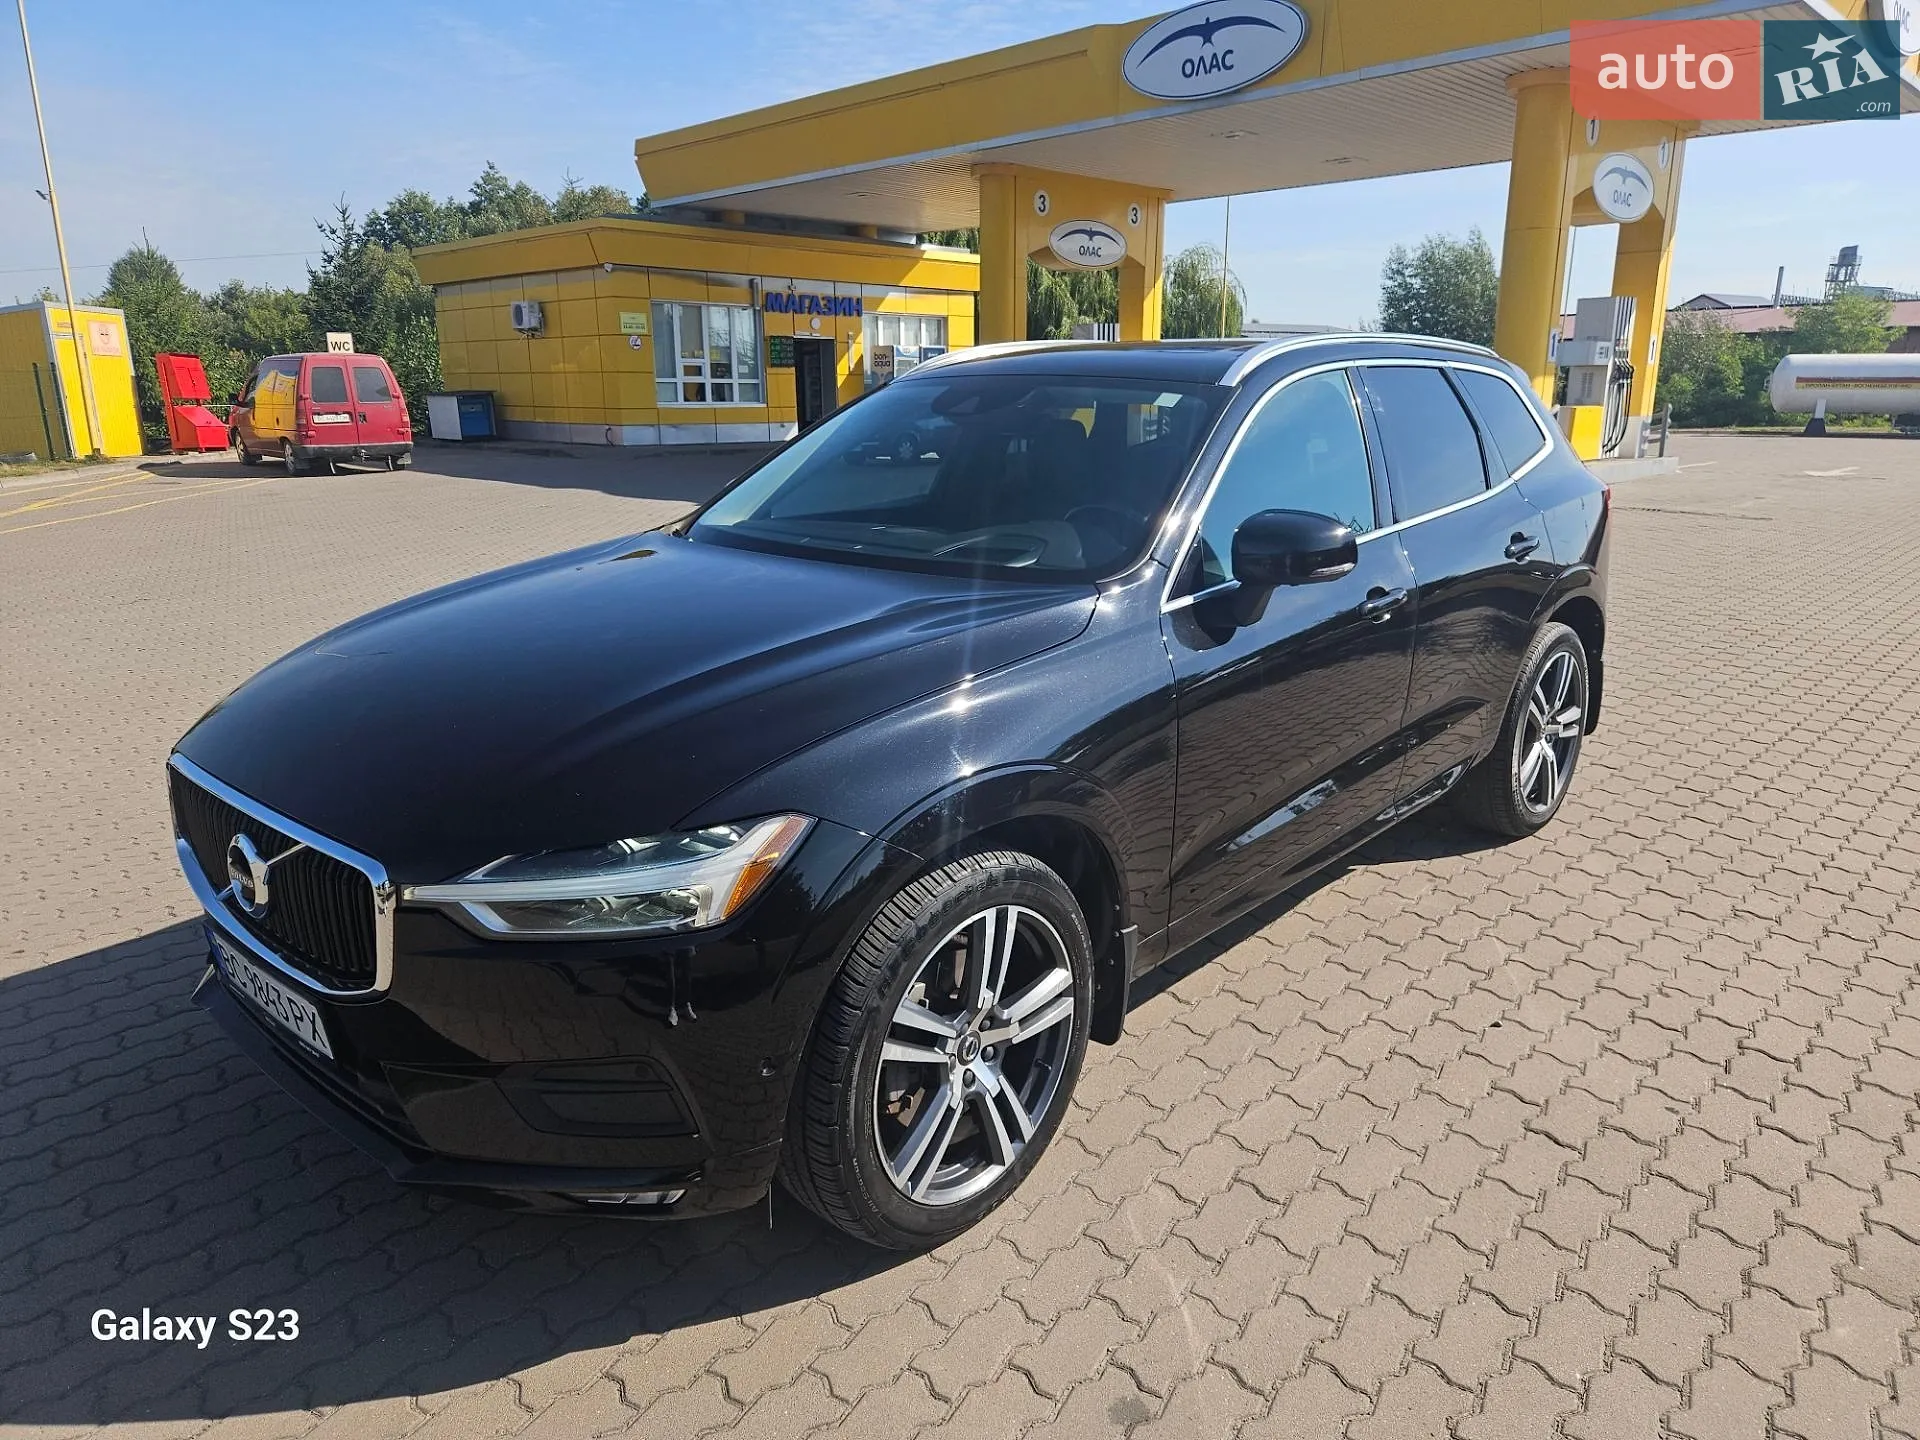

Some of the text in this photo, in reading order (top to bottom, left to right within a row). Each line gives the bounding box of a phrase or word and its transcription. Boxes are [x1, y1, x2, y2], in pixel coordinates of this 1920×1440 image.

[1181, 49, 1235, 78] ОЛАС
[1038, 194, 1047, 213] 3
[1130, 207, 1139, 224] 3
[1078, 245, 1102, 257] ОЛАС
[765, 292, 863, 317] МАГАЗИН
[330, 341, 351, 351] WC
